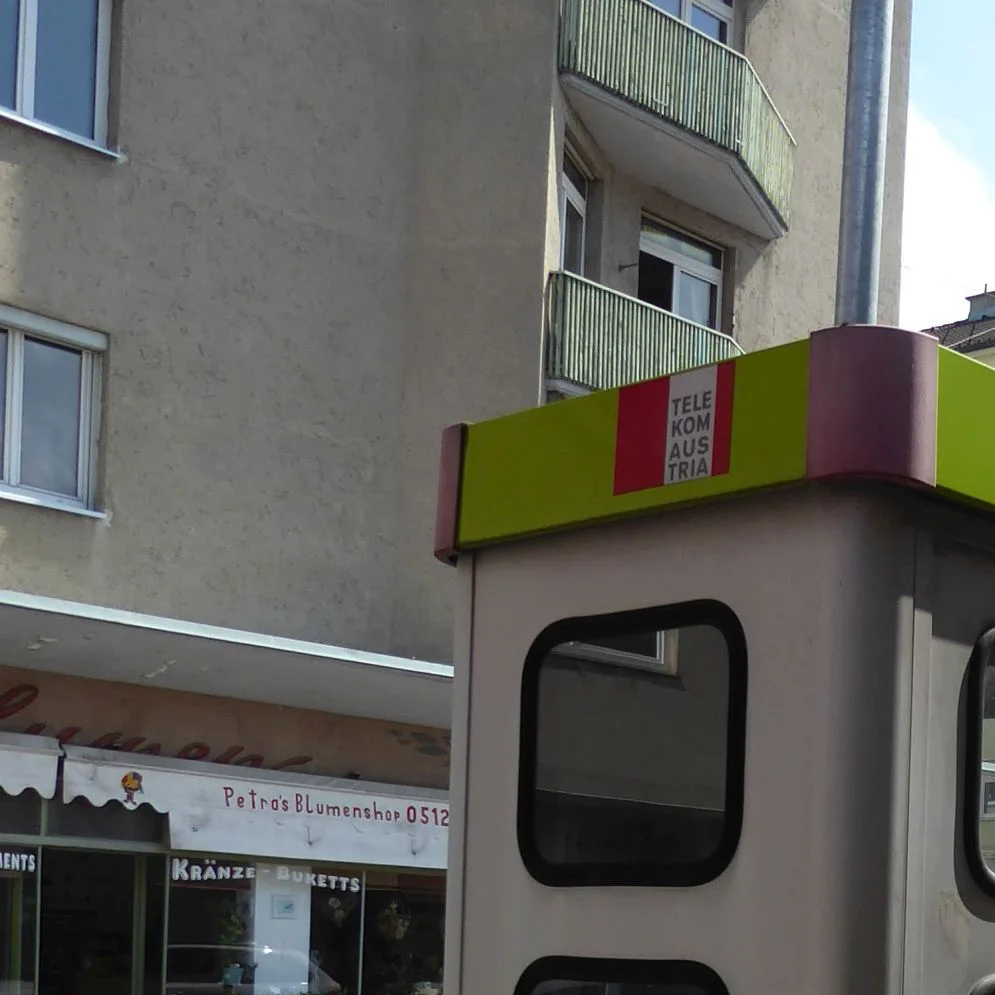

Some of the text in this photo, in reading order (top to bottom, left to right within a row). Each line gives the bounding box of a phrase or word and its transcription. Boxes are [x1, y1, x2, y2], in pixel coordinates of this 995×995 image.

[672, 391, 712, 416] TELE
[672, 413, 710, 438] KOM
[668, 436, 709, 461] AUS
[668, 458, 708, 481] TRIA
[223, 786, 289, 812] Petra's
[406, 805, 449, 827] 0512
